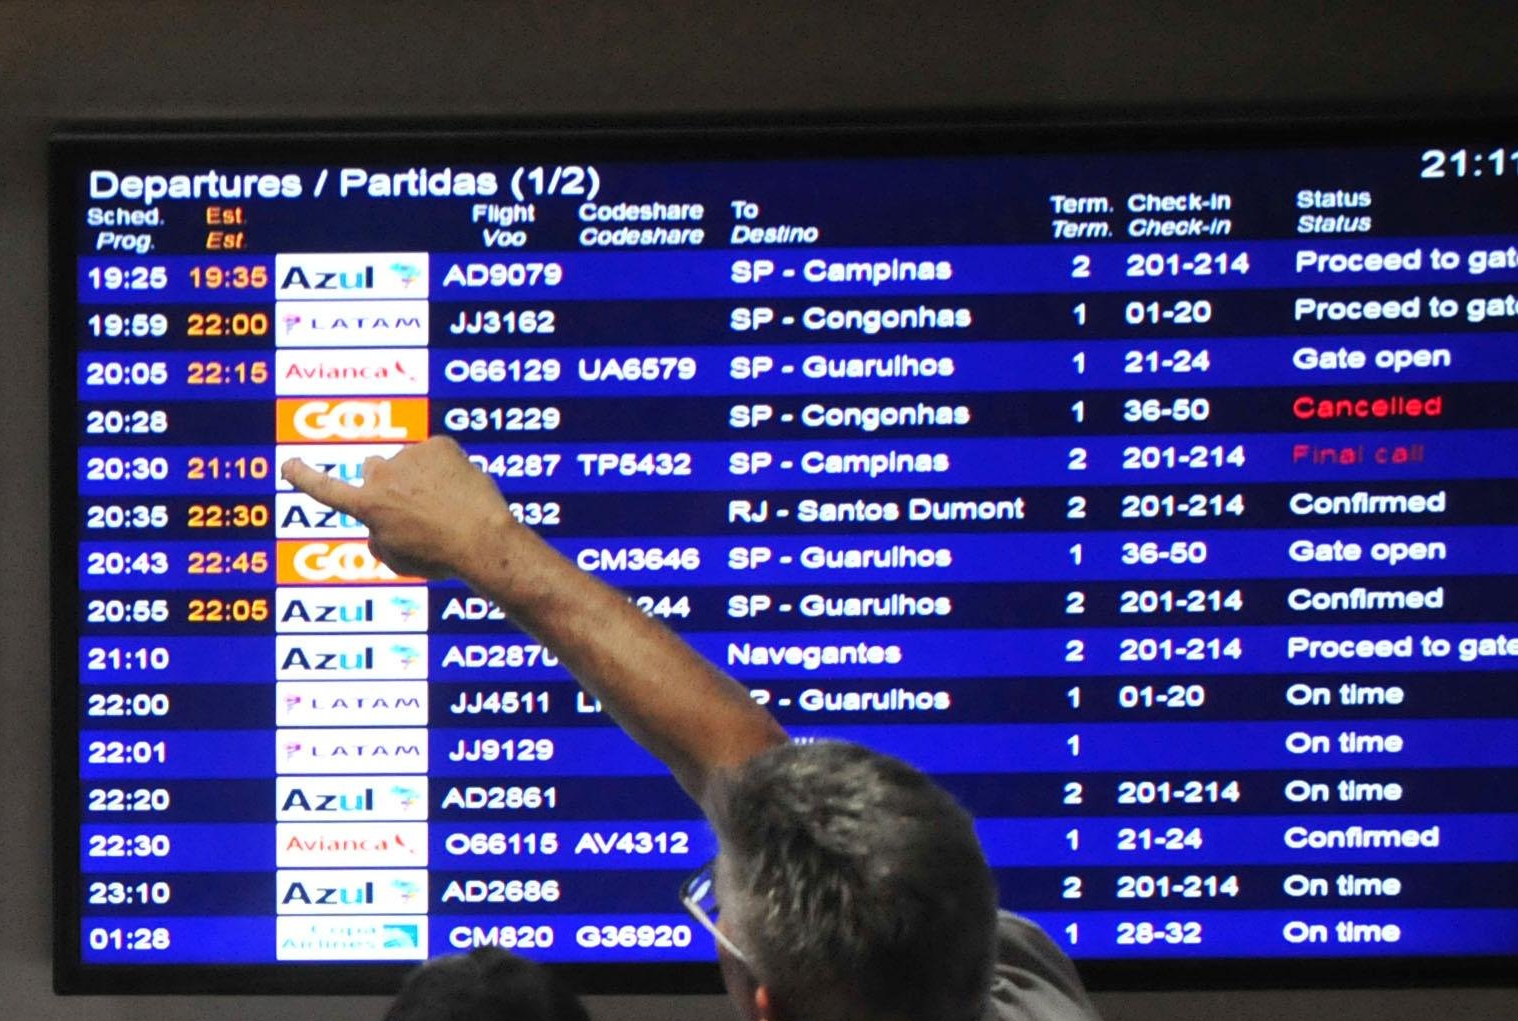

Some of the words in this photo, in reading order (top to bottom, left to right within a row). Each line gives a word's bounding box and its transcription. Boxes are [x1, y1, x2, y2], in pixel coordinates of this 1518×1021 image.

[90, 170, 302, 205] Departures
[314, 169, 328, 197] /
[341, 168, 498, 197] Partidas
[511, 166, 600, 201] (1/2)
[731, 201, 759, 219] To
[1050, 195, 1113, 213] Term.
[1128, 193, 1231, 212] Check-in
[1297, 190, 1371, 208] Status
[88, 207, 163, 225] Sched.
[473, 204, 535, 226] Flight
[579, 202, 704, 221] Codeshare
[731, 225, 819, 243] Destino
[1053, 220, 1112, 238] Term.
[1129, 218, 1231, 236] Check-in
[1298, 215, 1371, 233] Status
[97, 232, 151, 253] Prog.
[483, 229, 527, 247] Voo
[580, 227, 704, 245] Codeshare
[89, 266, 167, 289] 19:25
[190, 265, 268, 288] 19:35
[280, 266, 374, 290] Azul
[443, 263, 563, 286] AD9079
[450, 310, 555, 334] JJ3162
[1126, 300, 1211, 324] 01-20
[89, 314, 168, 336] 19:59
[187, 313, 269, 336] 22:00
[311, 317, 421, 330] LATAM
[285, 363, 388, 379] Avianca
[579, 357, 696, 380] UA6579
[1125, 350, 1210, 373] 21-24
[1293, 348, 1366, 369] Gate
[1375, 349, 1451, 372] open
[87, 362, 168, 385] 20:05
[187, 361, 269, 384] 22:15
[445, 407, 560, 430] G31229
[1124, 398, 1210, 421] 36-50
[1293, 396, 1442, 419] Cancelled
[87, 411, 168, 433] 20:28
[293, 401, 408, 439] GOL
[188, 457, 269, 479] 21:10
[577, 453, 691, 476] TP5432
[1290, 491, 1446, 514] Confirmed
[728, 642, 902, 670] Navegantes
[1120, 638, 1242, 660] 201-214
[1288, 636, 1412, 658] Proceed
[1421, 636, 1451, 656] to
[451, 692, 549, 713] JJ4511
[449, 739, 554, 761] JJ9129
[442, 787, 556, 808] AD2861
[575, 832, 689, 854] AV4312
[442, 880, 560, 902] AD2686
[90, 928, 170, 949] 01:28
[449, 926, 554, 948] CM820
[576, 925, 692, 948] G36920
[1117, 922, 1202, 944] 28-32
